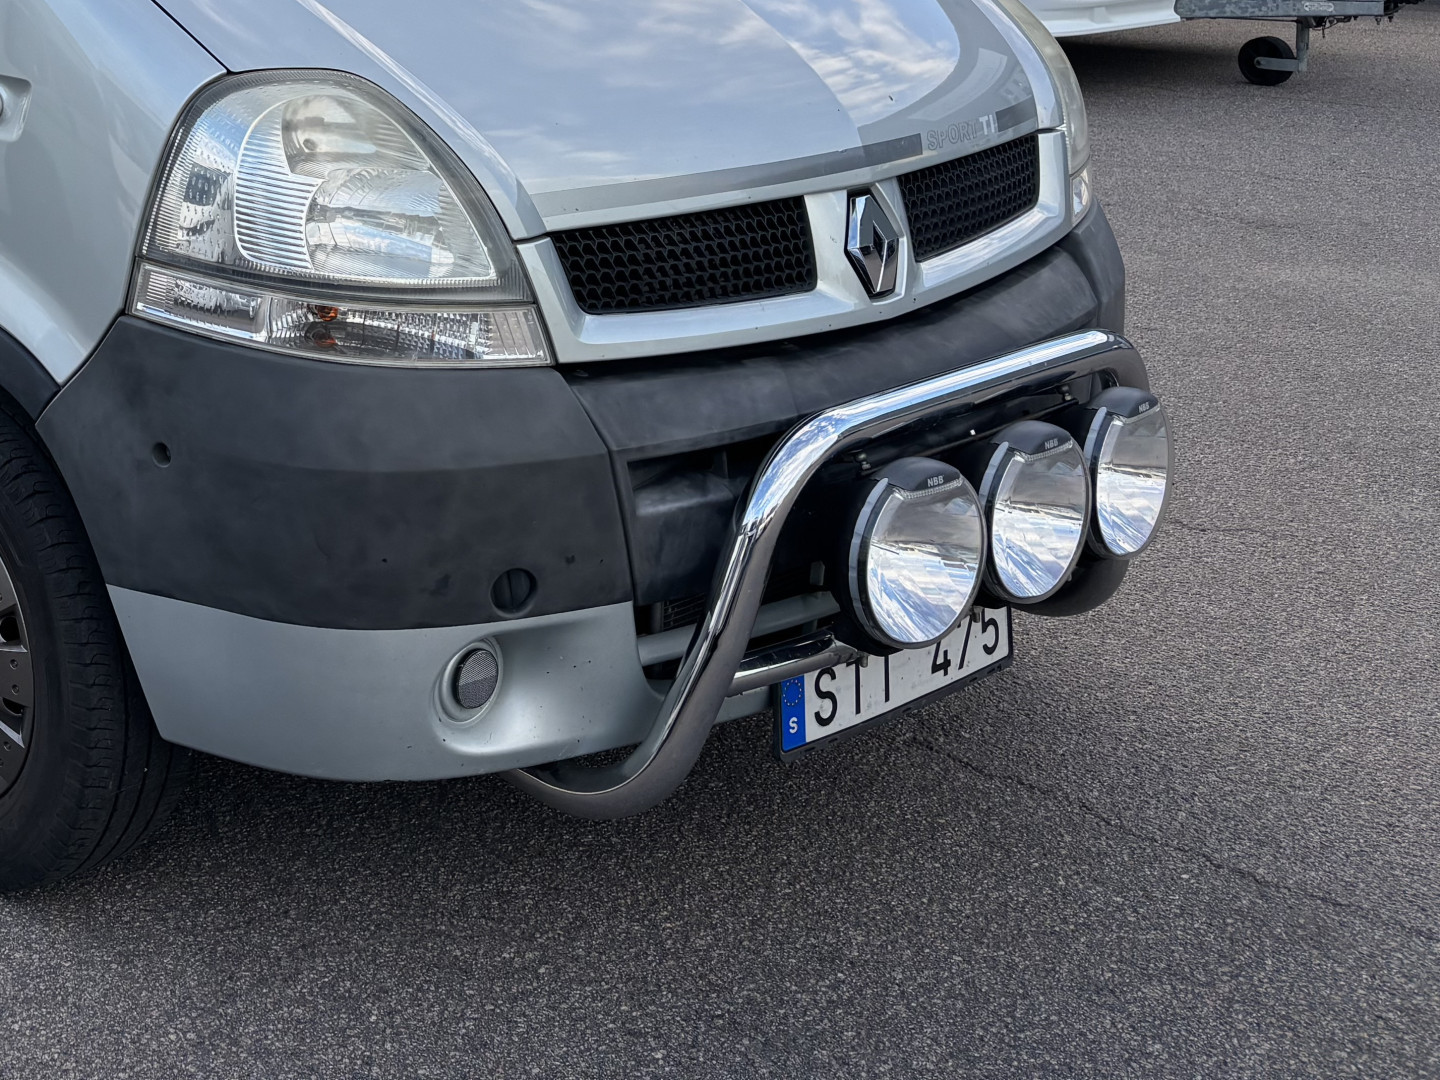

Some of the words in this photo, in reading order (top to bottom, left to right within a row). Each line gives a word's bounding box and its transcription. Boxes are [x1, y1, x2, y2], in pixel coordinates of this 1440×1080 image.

[926, 121, 978, 151] SPORT
[927, 475, 944, 488] NBB
[788, 717, 798, 734] S
